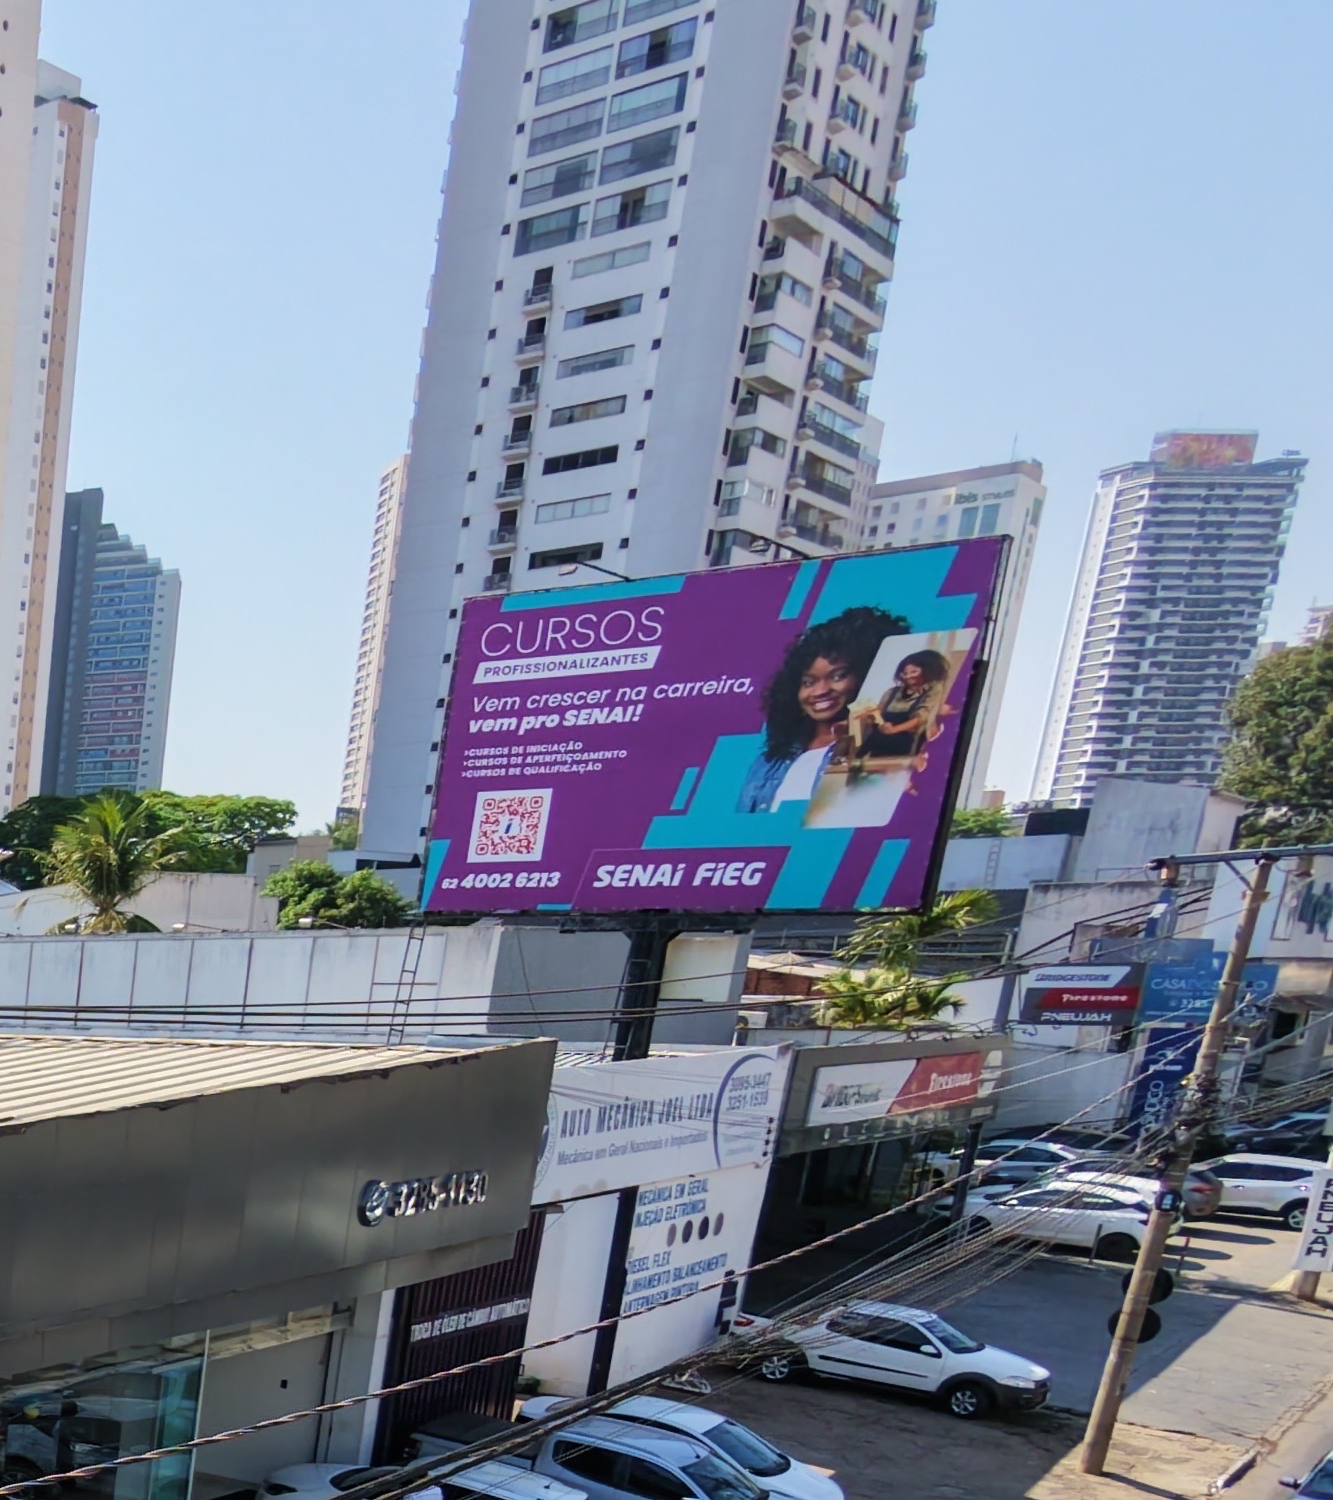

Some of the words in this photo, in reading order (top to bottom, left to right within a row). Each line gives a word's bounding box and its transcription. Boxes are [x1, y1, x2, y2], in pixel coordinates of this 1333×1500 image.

[481, 606, 665, 657] CURSOS
[483, 652, 648, 678] PROFISSIONALIZANTES
[473, 695, 521, 714] Vem
[526, 688, 610, 710] crescer
[615, 685, 647, 702] na
[653, 675, 755, 700] carreira,
[469, 716, 517, 734] vem
[518, 713, 561, 736] pro
[562, 704, 644, 727] SENAI!
[467, 756, 508, 768] CURSOS
[525, 750, 627, 764] APERFEIÇOAMENTO
[468, 744, 509, 757] CURSOS
[511, 744, 525, 755] DE
[526, 740, 583, 754] INICIAÇÃO
[465, 767, 506, 778] CURSOS
[523, 762, 602, 776] QUALIFICAÇÃO
[441, 878, 458, 889] 62
[460, 872, 512, 889] 4002
[515, 871, 561, 888] 6213
[560, 1107, 591, 1138] AUTO
[595, 1096, 655, 1133] MECÂNICA
[658, 1095, 684, 1124] JOEL
[688, 1092, 715, 1120] LTDA
[557, 1150, 593, 1165] Mecânica
